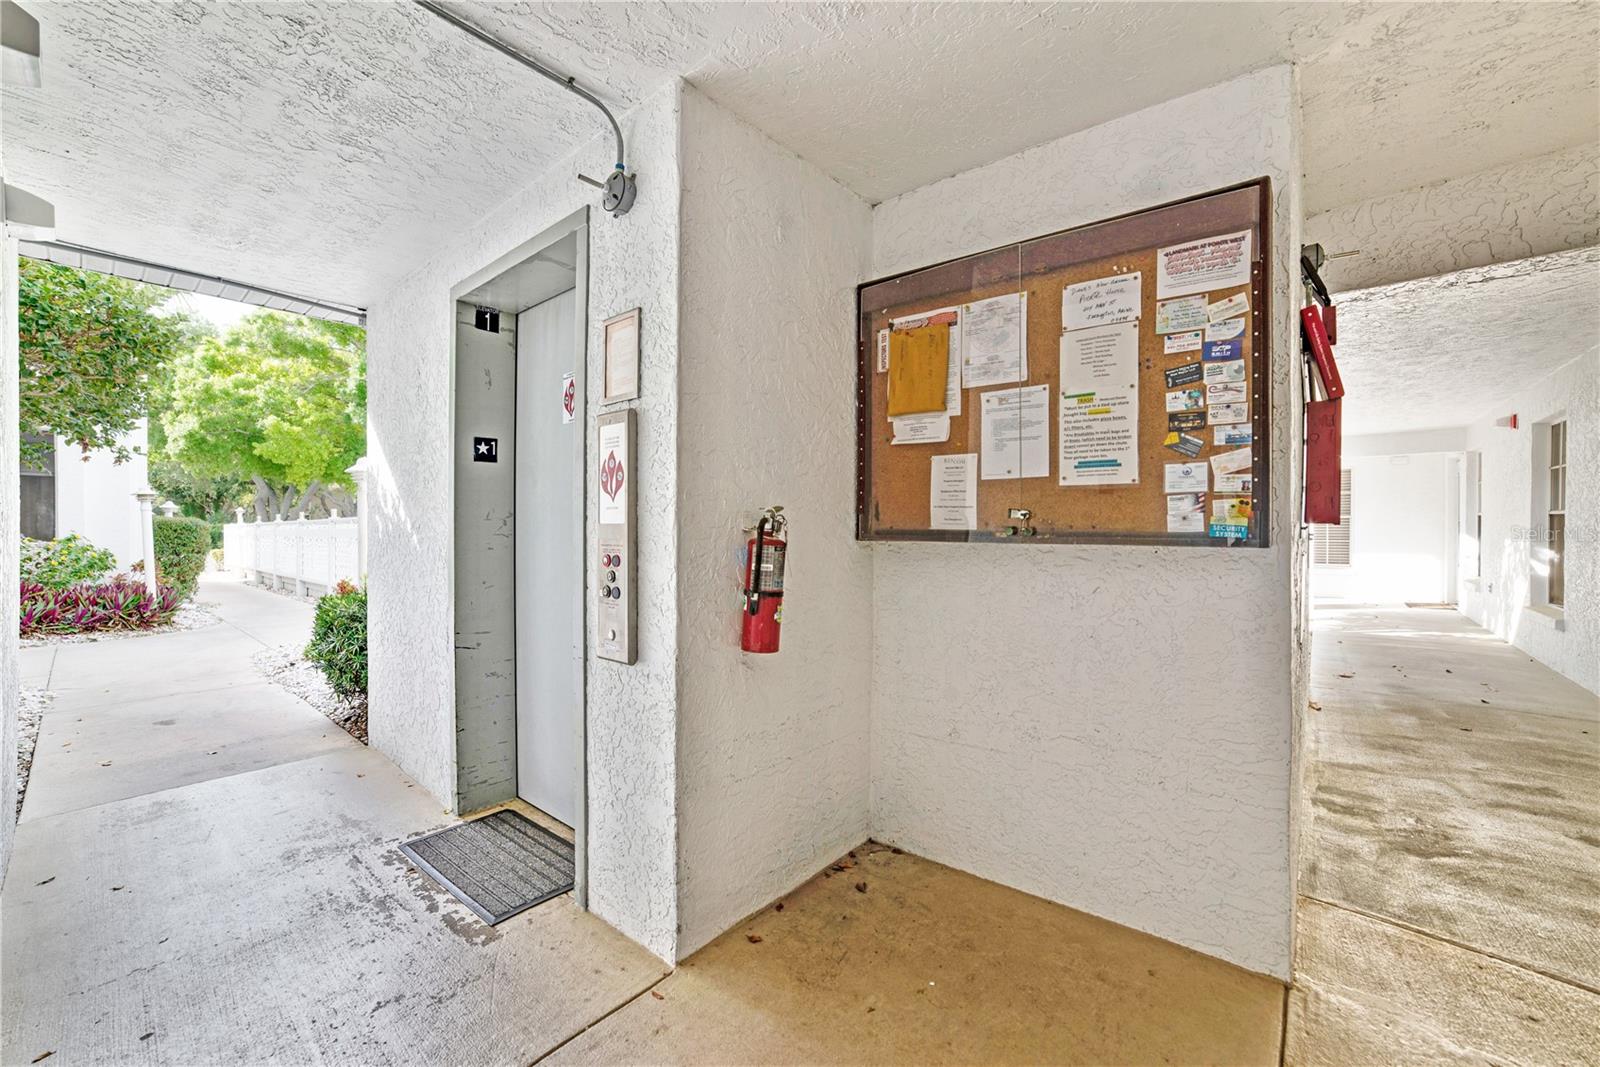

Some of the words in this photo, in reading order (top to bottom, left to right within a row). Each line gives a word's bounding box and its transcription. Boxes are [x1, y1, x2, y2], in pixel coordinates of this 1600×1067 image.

[1168, 245, 1200, 256] LANDMARK
[485, 312, 490, 331] 1
[490, 441, 495, 455] 1
